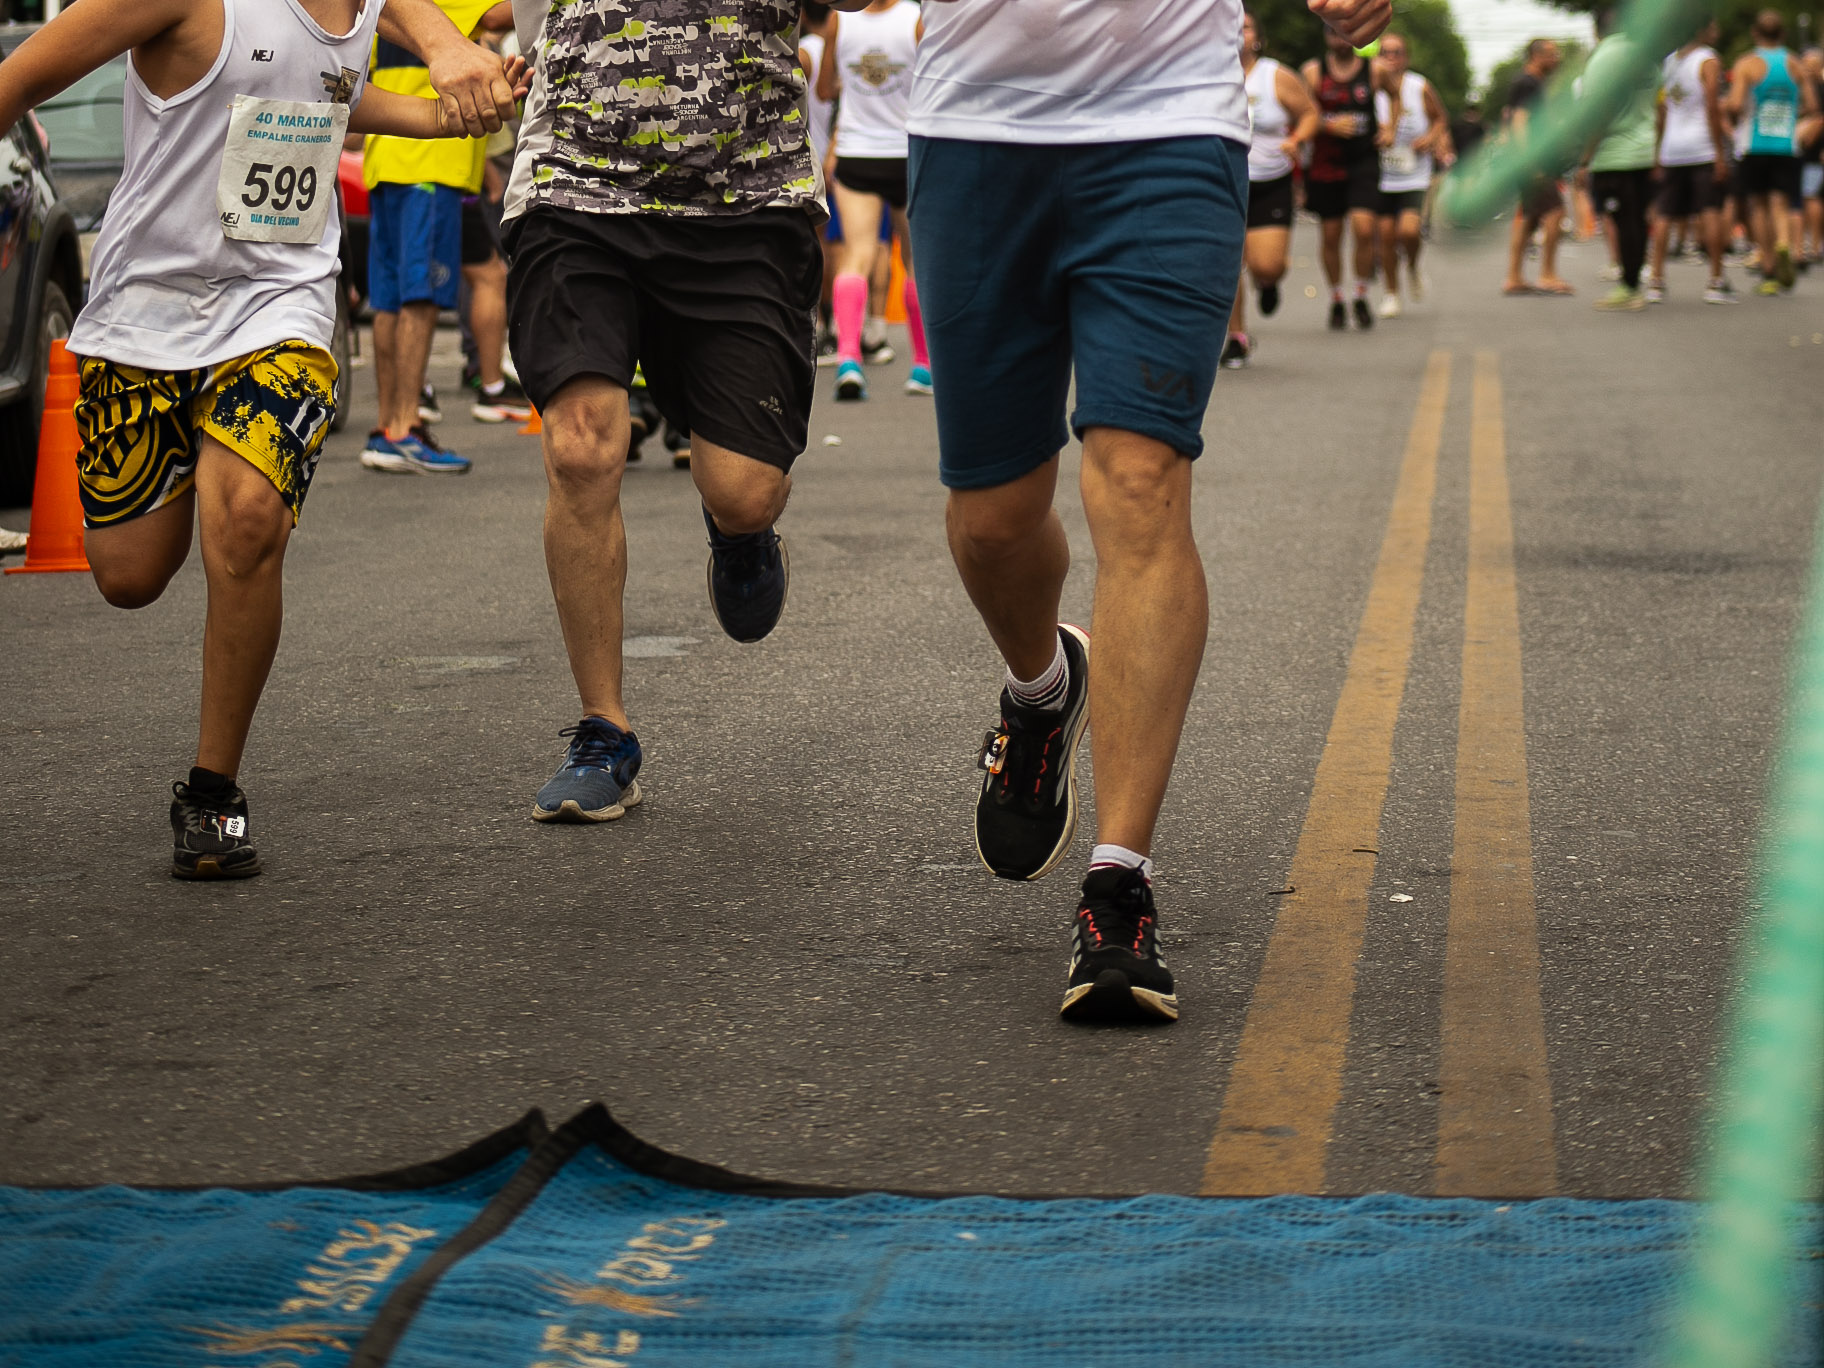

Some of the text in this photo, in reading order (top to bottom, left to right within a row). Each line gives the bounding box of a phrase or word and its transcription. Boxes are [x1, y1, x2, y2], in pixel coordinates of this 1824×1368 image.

[250, 49, 274, 62] NEJ
[256, 112, 333, 129] 40 MARATON
[247, 129, 332, 144] EMPALME GRANEROS
[241, 162, 317, 212] 599
[229, 819, 240, 834] 599
